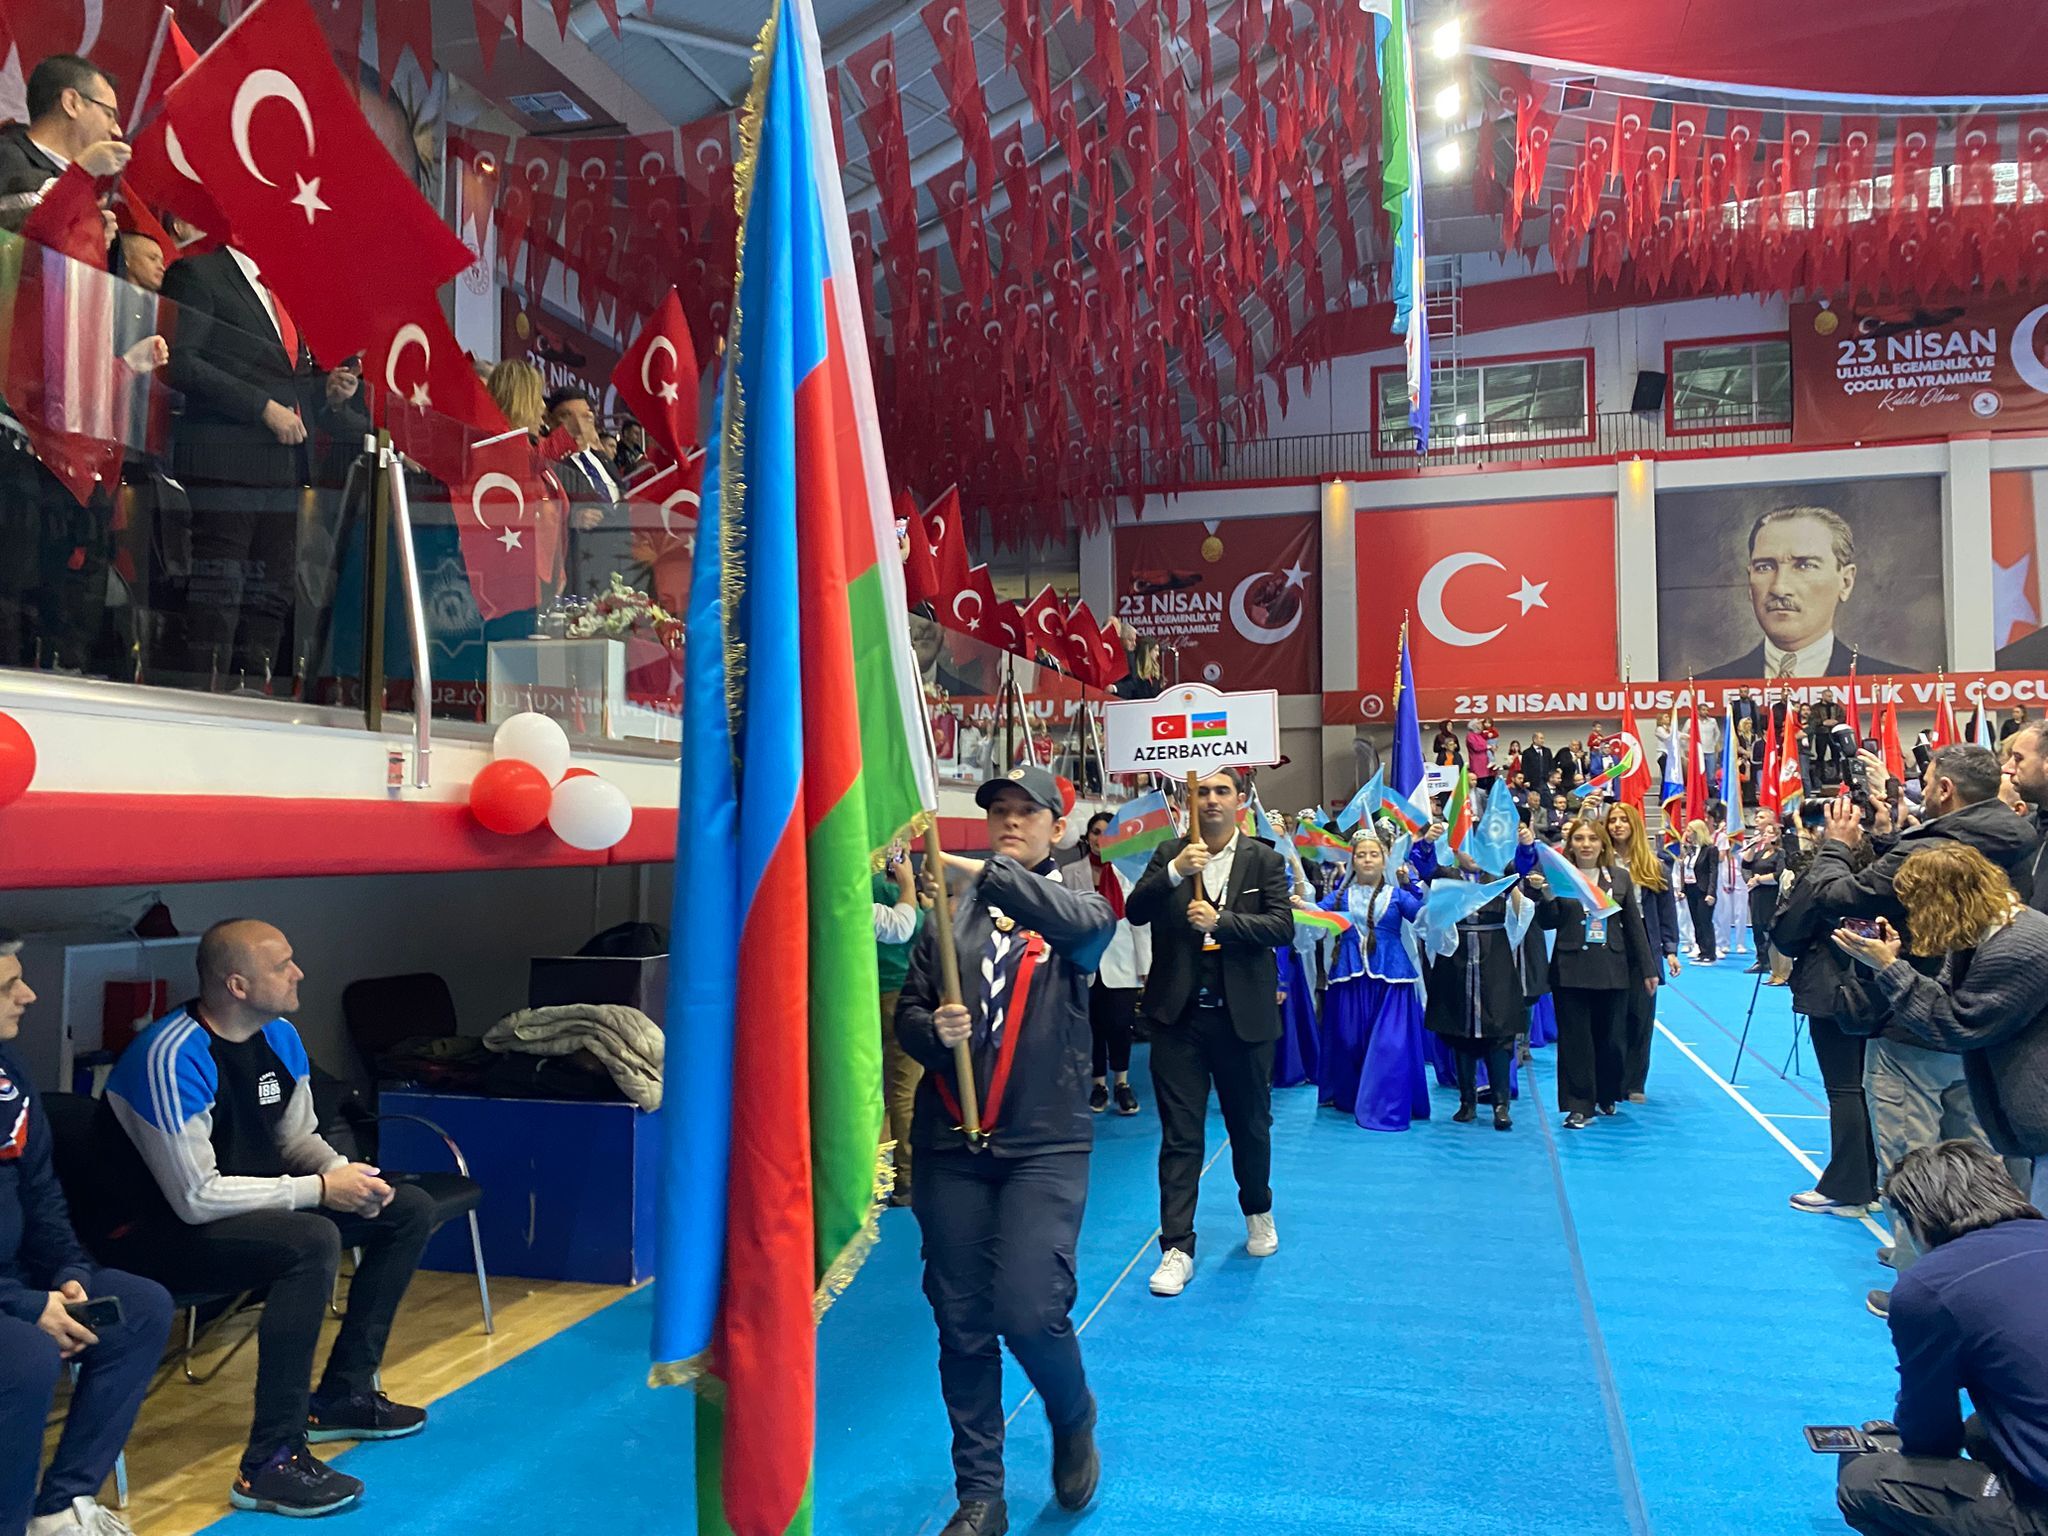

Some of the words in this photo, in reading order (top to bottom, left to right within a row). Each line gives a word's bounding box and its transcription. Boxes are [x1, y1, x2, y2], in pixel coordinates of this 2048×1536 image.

[1837, 338, 1877, 366] 23
[1888, 329, 1997, 361] NİSAN
[1836, 364, 1890, 380] ULUSAL
[1893, 355, 1973, 375] EGEMENLİK
[1975, 355, 1995, 368] VE
[1844, 378, 1895, 396] ÇOCUK
[1898, 371, 1992, 388] BAYRAMIMIZ
[1119, 595, 1145, 615] 23
[1151, 589, 1223, 614] NİSAN
[1208, 612, 1221, 622] VE
[1135, 626, 1156, 637] CUK
[1454, 694, 1489, 714] 23
[1595, 690, 1715, 711] ULUSAL
[1911, 682, 1956, 703] VE
[1133, 741, 1248, 762] AZERBAYCAN
